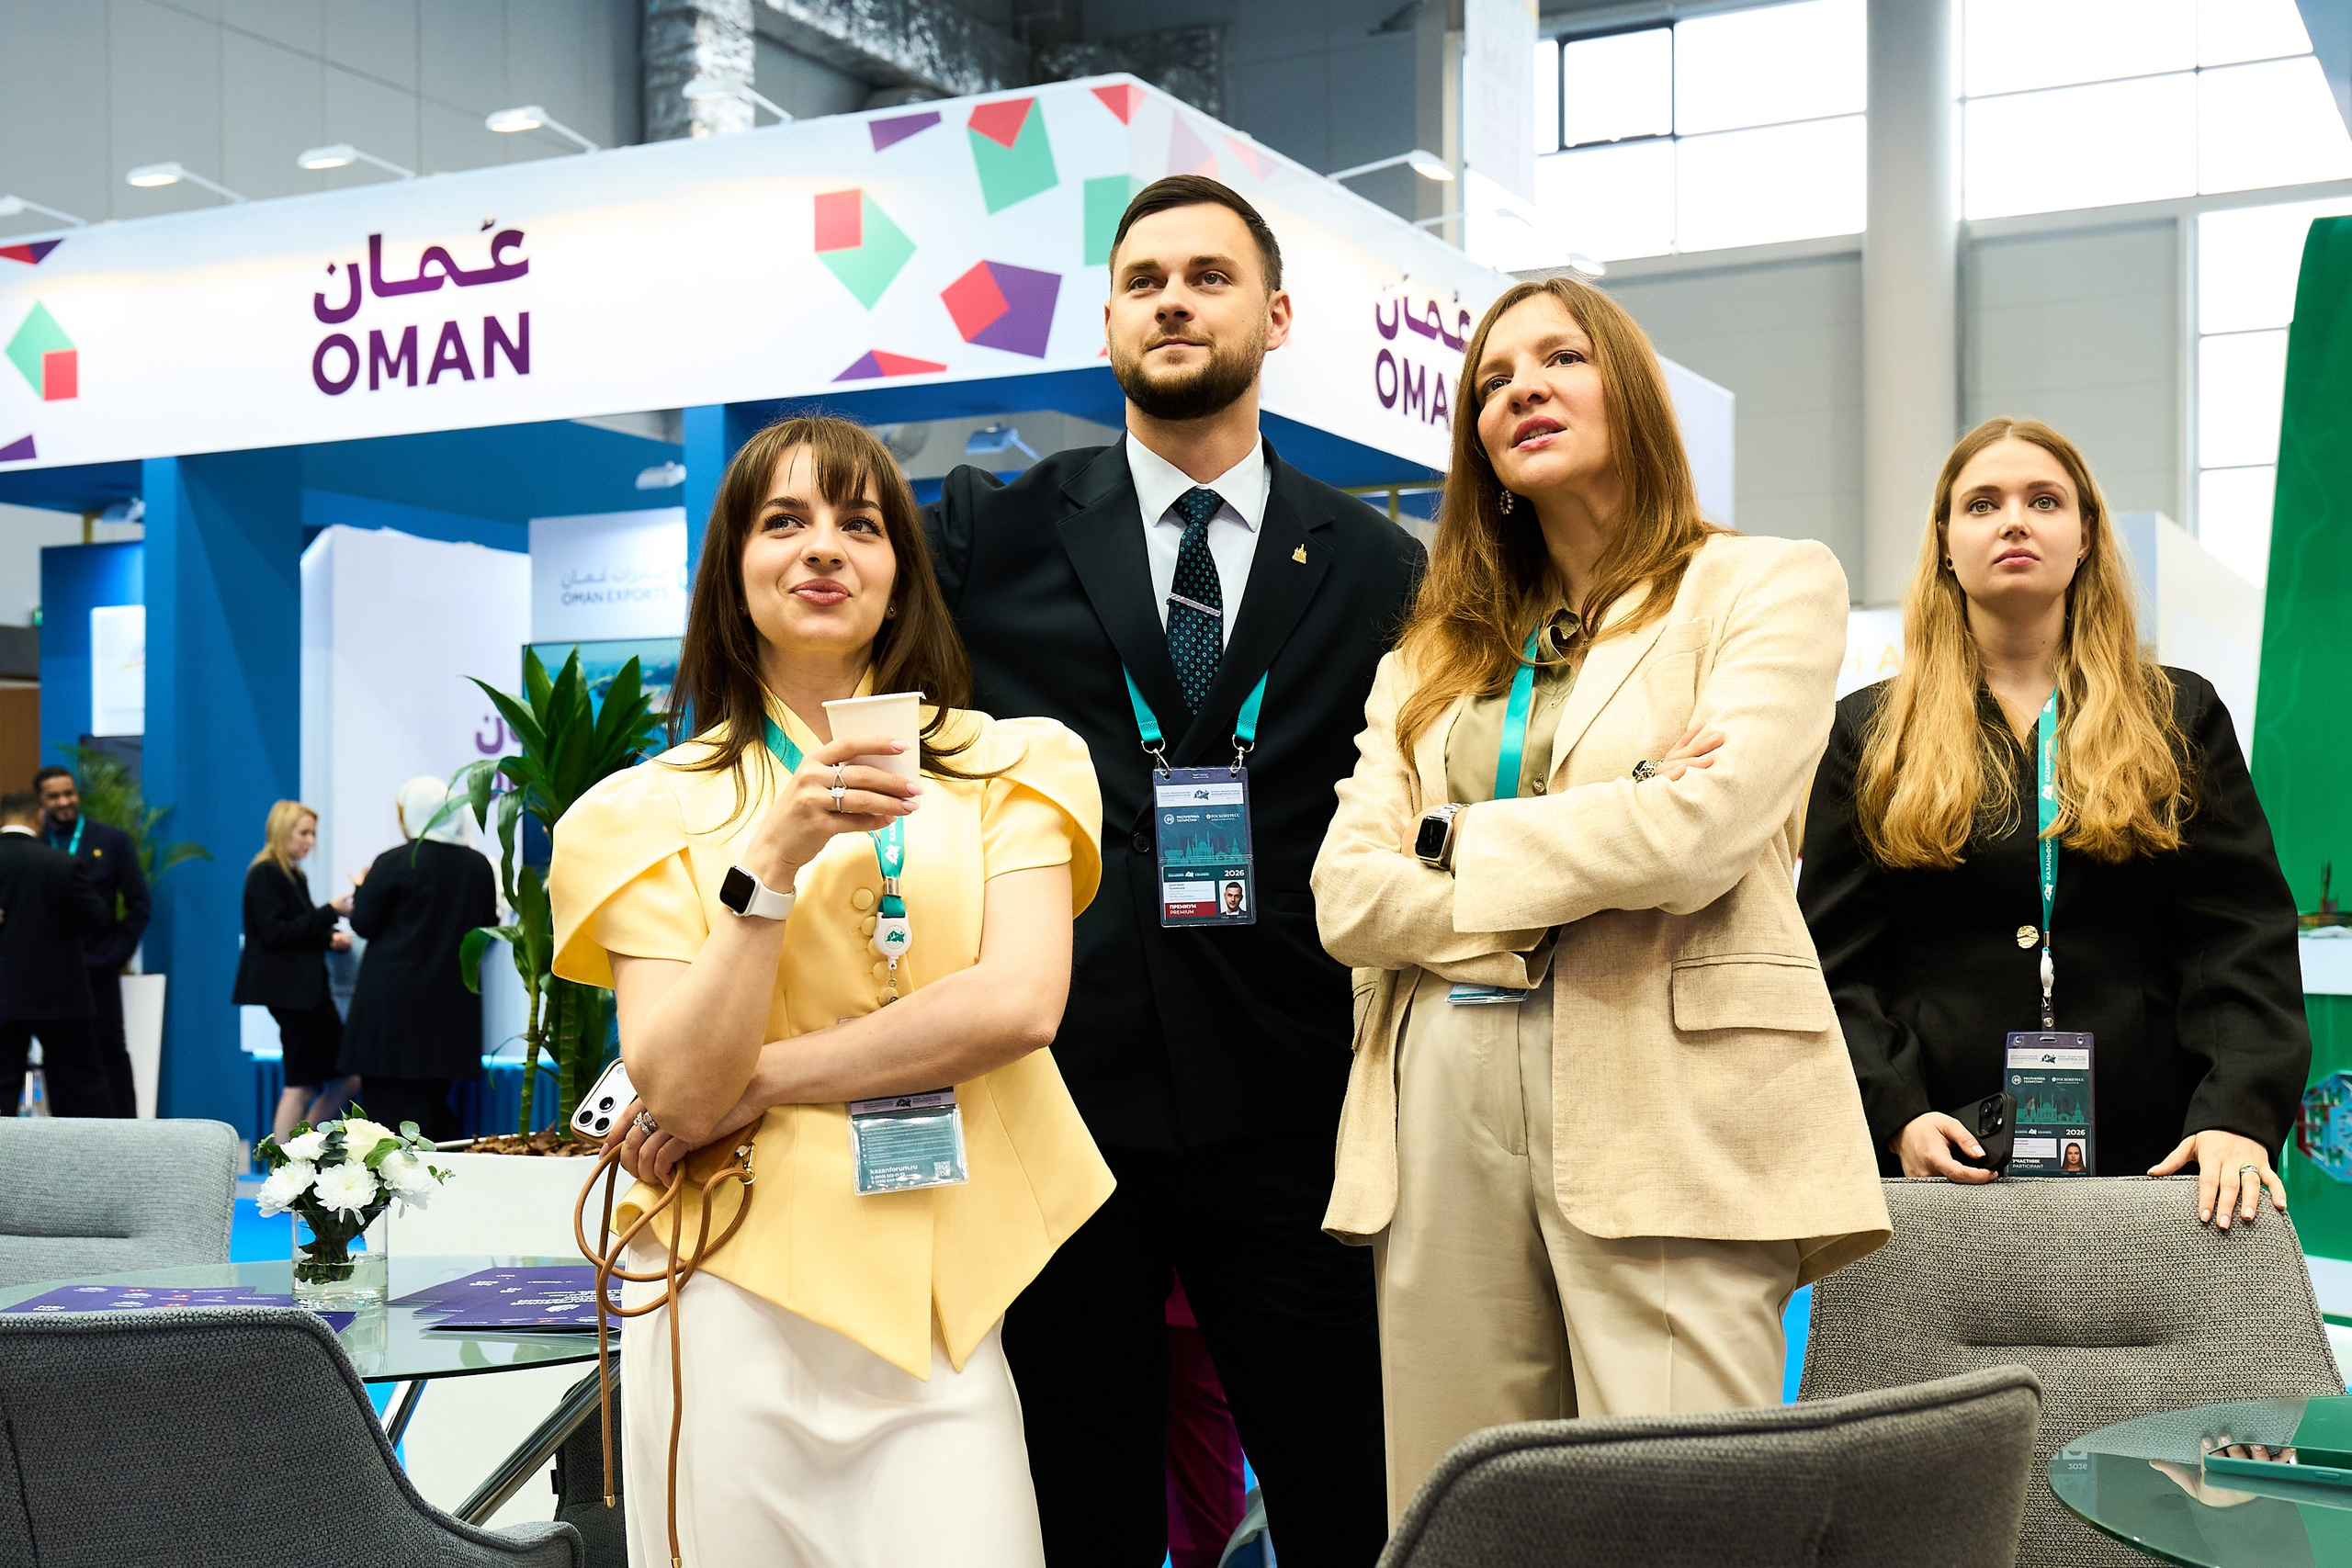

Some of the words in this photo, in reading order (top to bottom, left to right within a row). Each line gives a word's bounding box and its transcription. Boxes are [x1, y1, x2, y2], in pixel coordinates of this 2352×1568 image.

[312, 311, 530, 396] OMAN
[1375, 348, 1457, 431] OMA
[560, 591, 604, 606] OMAN
[607, 588, 669, 604] EXPORTS
[1224, 869, 1245, 877] 2026
[870, 1165, 918, 1175] kazanforum.ru
